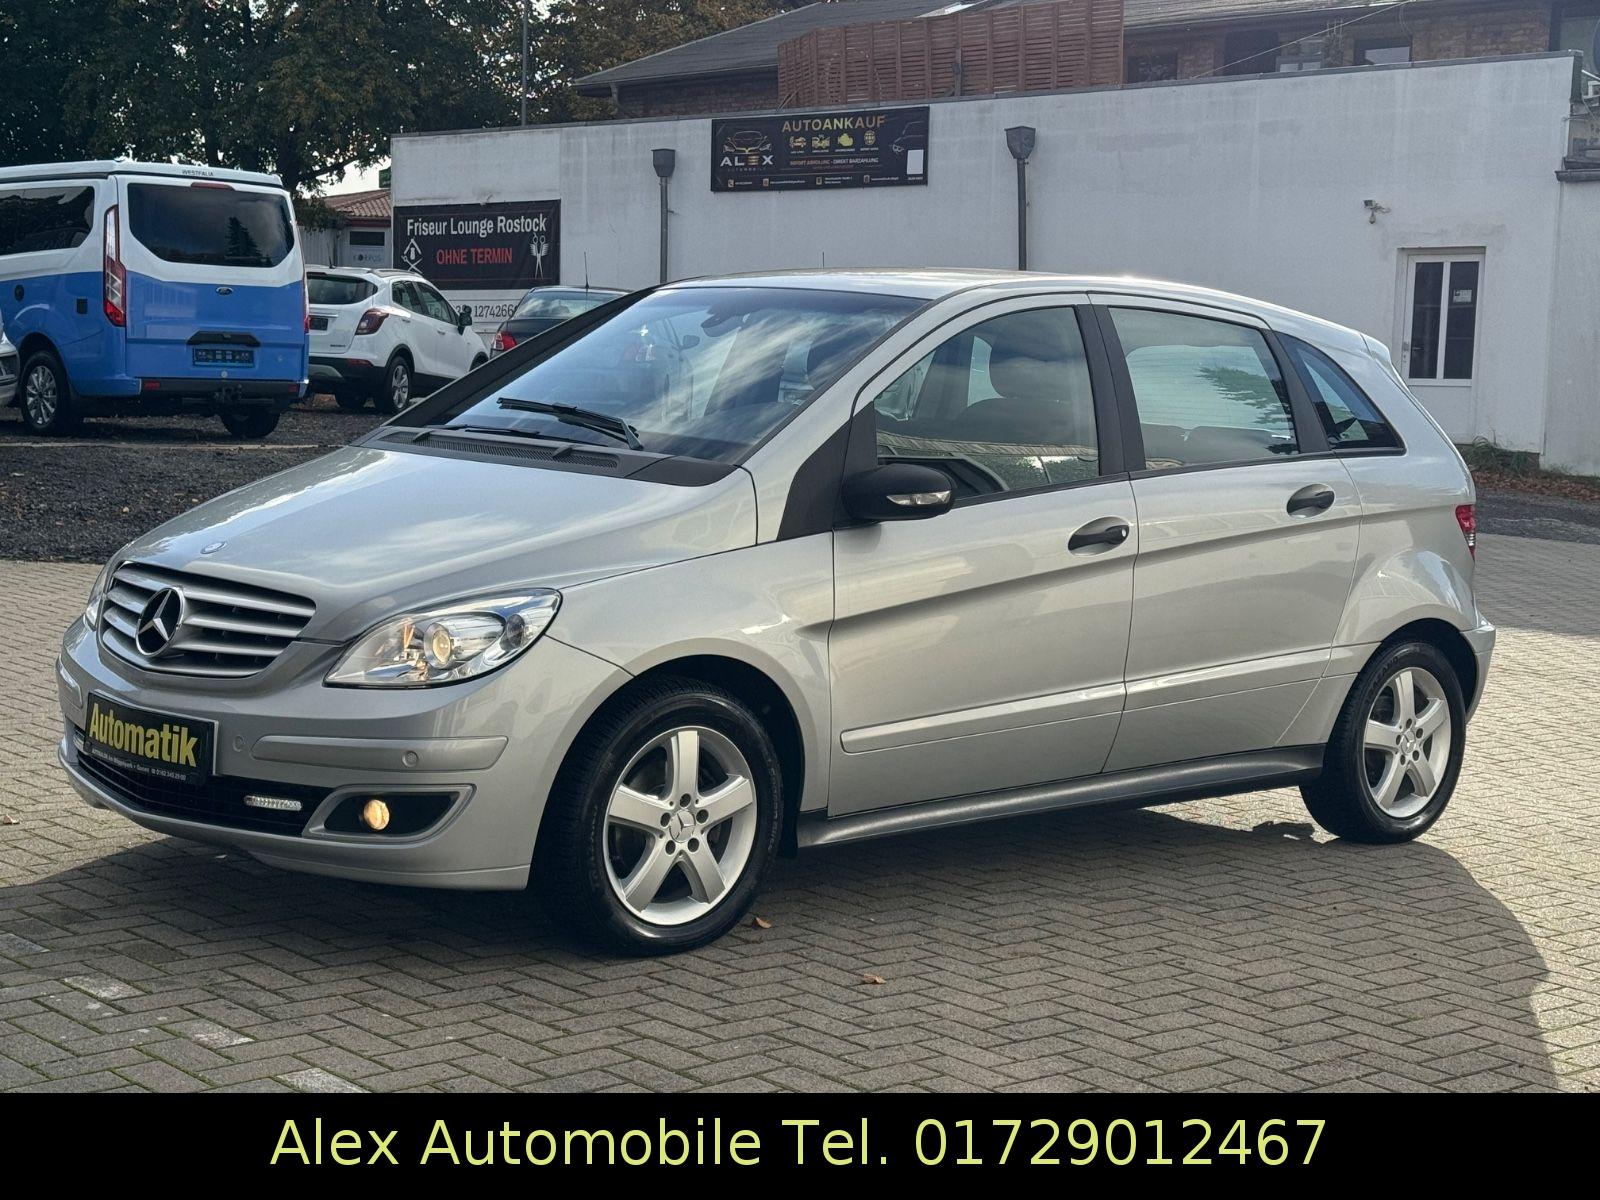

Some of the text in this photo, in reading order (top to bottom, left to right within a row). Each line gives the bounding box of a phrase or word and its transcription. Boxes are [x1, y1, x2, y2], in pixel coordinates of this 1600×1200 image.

[782, 115, 886, 133] AUTOANKAUF
[720, 154, 774, 168] ALEX
[181, 169, 214, 177] WESTFALIA
[406, 213, 547, 238] Friseur Lounge Rostock
[436, 247, 513, 265] OHNE TERMIN
[89, 703, 198, 767] Automatik
